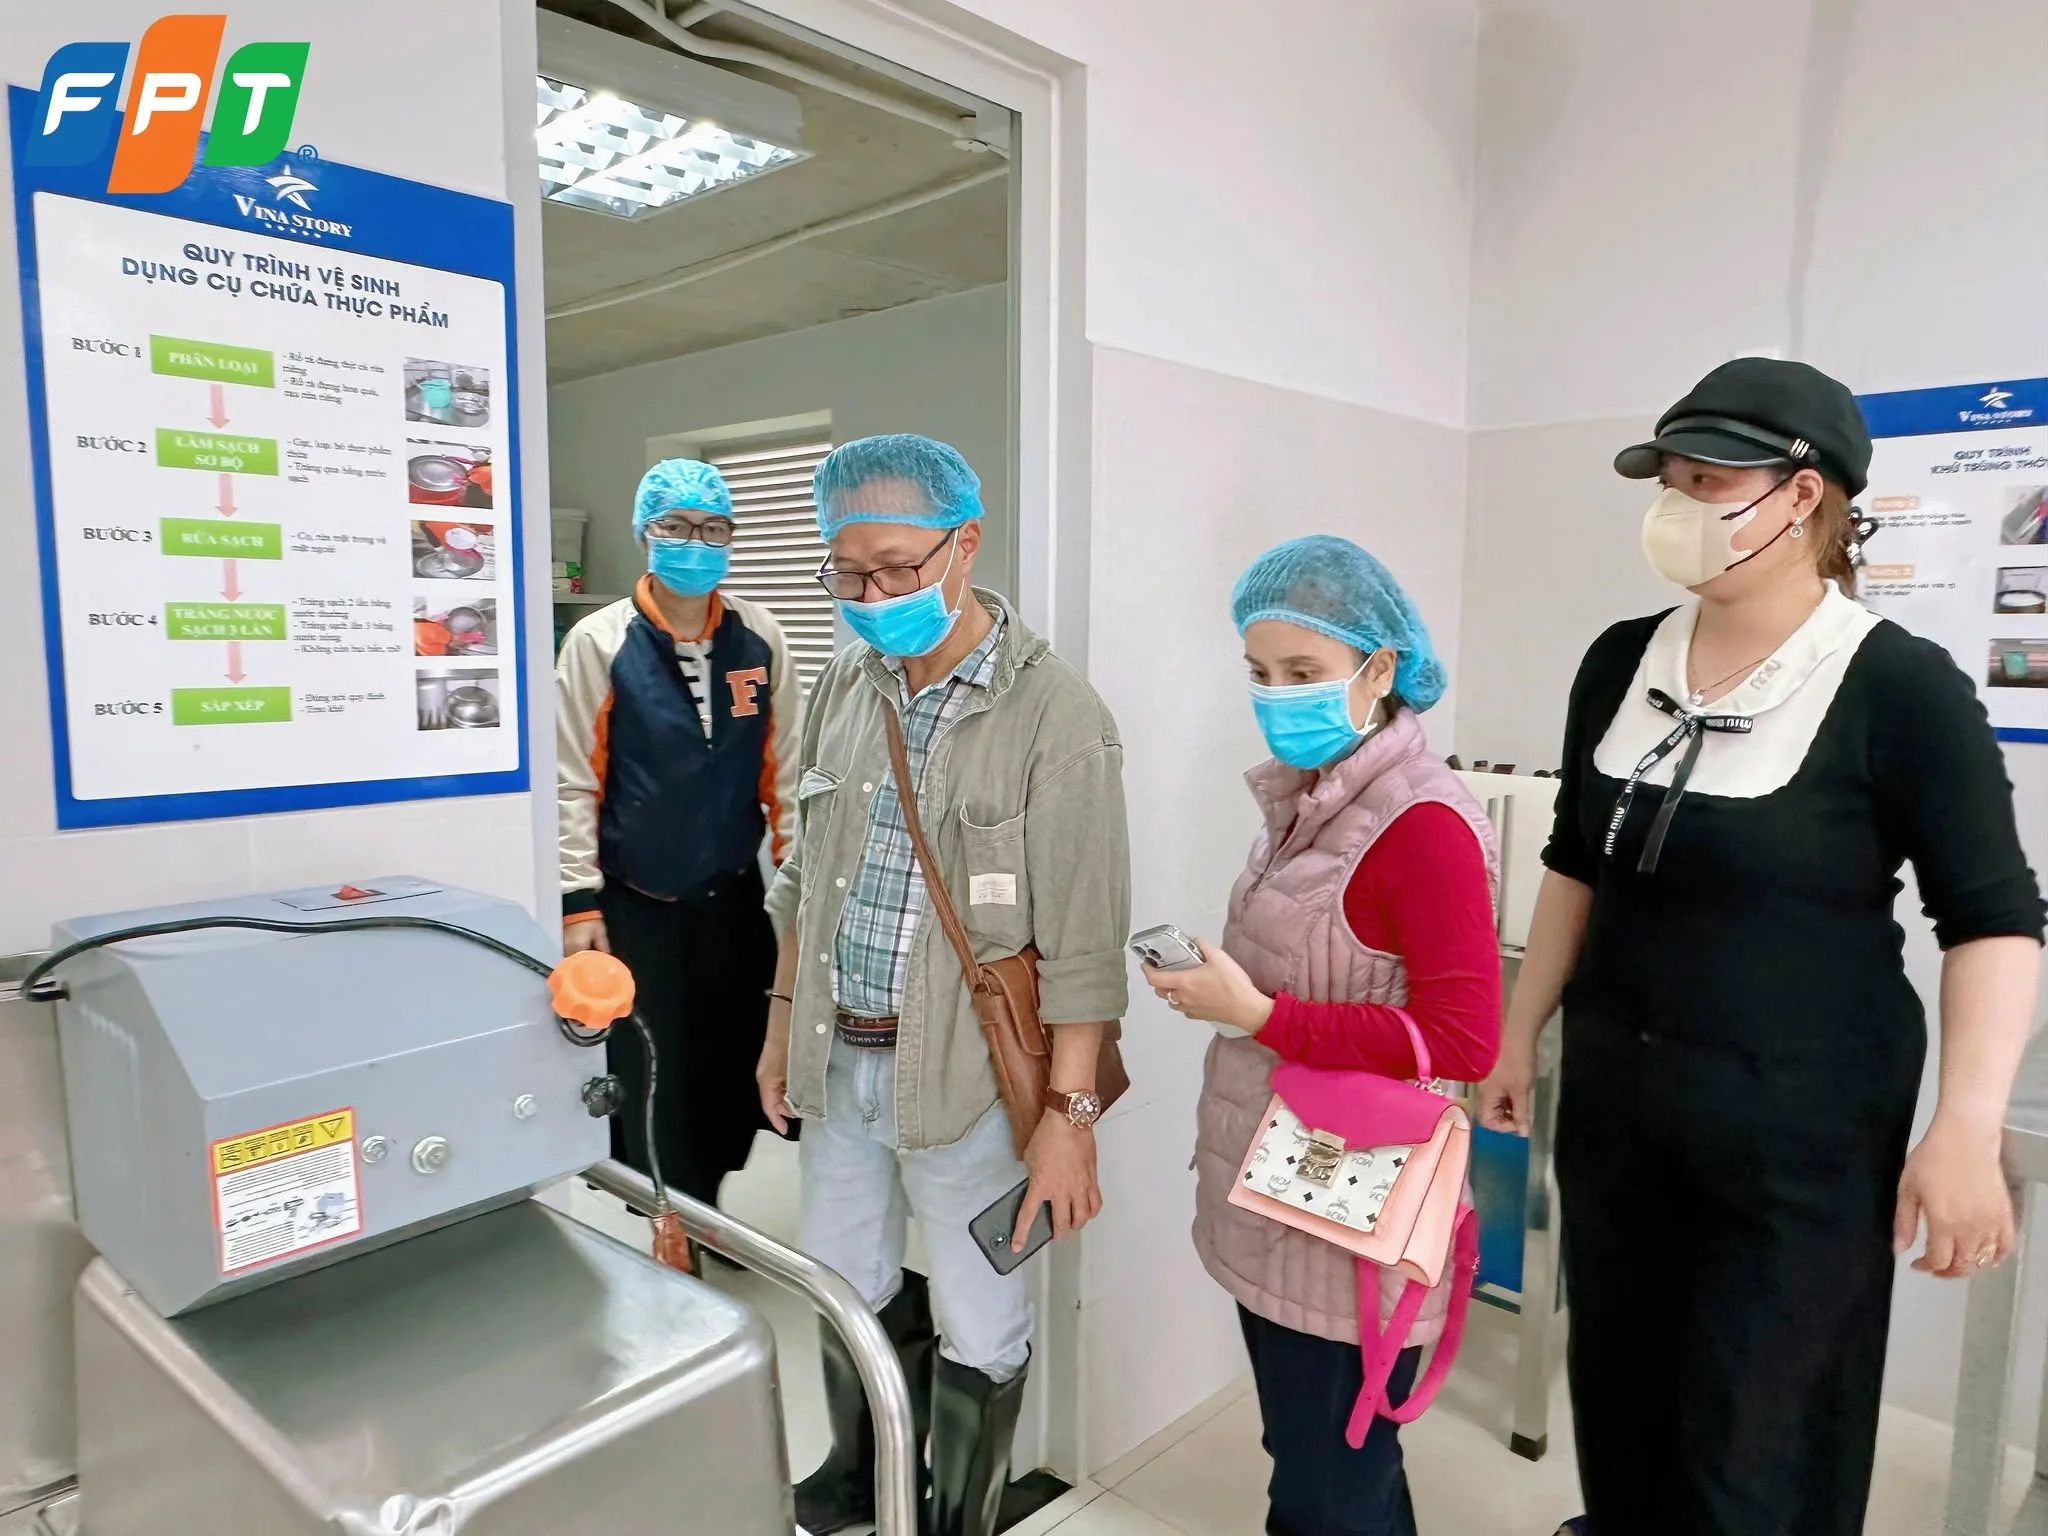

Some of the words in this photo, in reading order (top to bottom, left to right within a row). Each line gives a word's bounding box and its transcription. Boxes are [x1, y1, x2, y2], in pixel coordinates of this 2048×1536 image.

[291, 213, 353, 238] STORY
[182, 243, 236, 268] QUY
[242, 253, 311, 282] TRÌNH
[317, 266, 346, 292] VỆ
[350, 274, 401, 298] SINH
[122, 256, 199, 285] DỤNG
[206, 272, 242, 298] CỤ
[323, 292, 384, 319] THỰC
[389, 301, 450, 329] PHẨM
[137, 441, 148, 454] 2
[142, 530, 153, 543] 3
[147, 614, 159, 626] 4
[725, 666, 769, 718] F
[152, 701, 163, 715] 5
